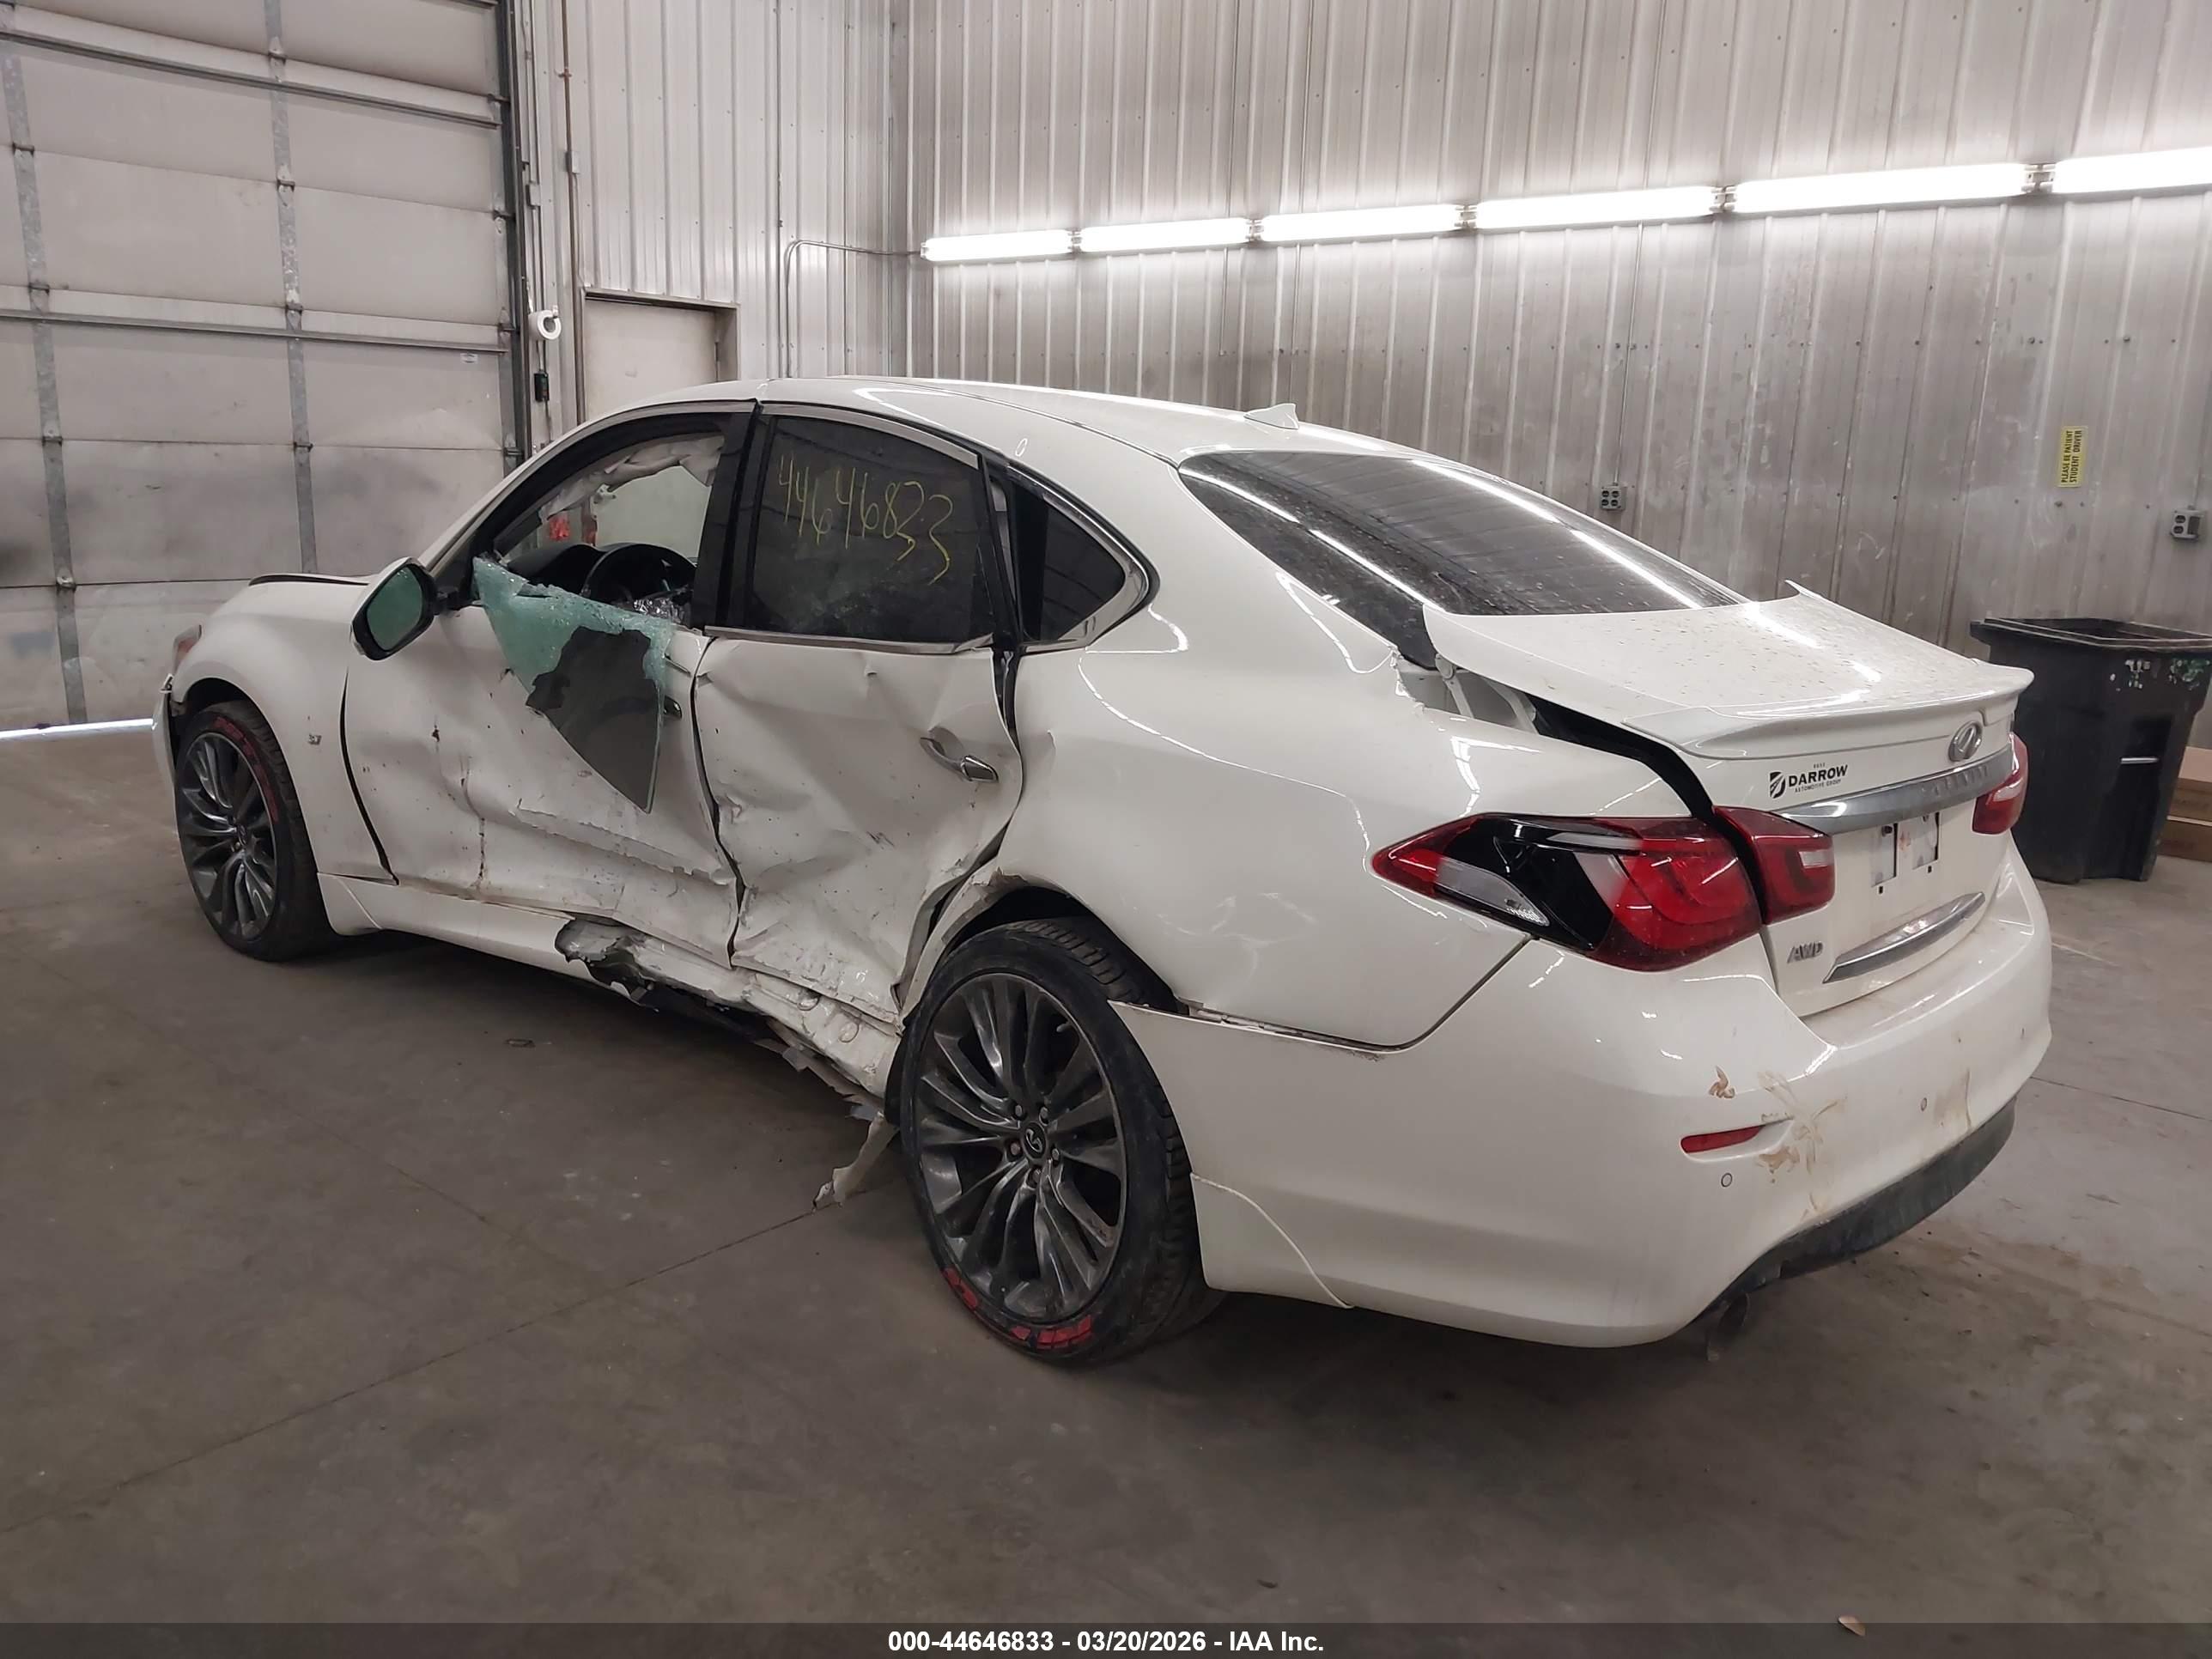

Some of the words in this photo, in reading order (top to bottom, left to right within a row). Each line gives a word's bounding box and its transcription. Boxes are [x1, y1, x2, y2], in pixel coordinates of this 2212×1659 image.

[2064, 430, 2073, 453] PATIENT
[2073, 430, 2081, 453] DRIVER
[2061, 463, 2069, 483] PLEASE
[2069, 456, 2080, 483] STUDENT
[778, 453, 954, 586] 44646833
[1788, 763, 1849, 787] DARROW
[1787, 941, 1824, 964] AWD
